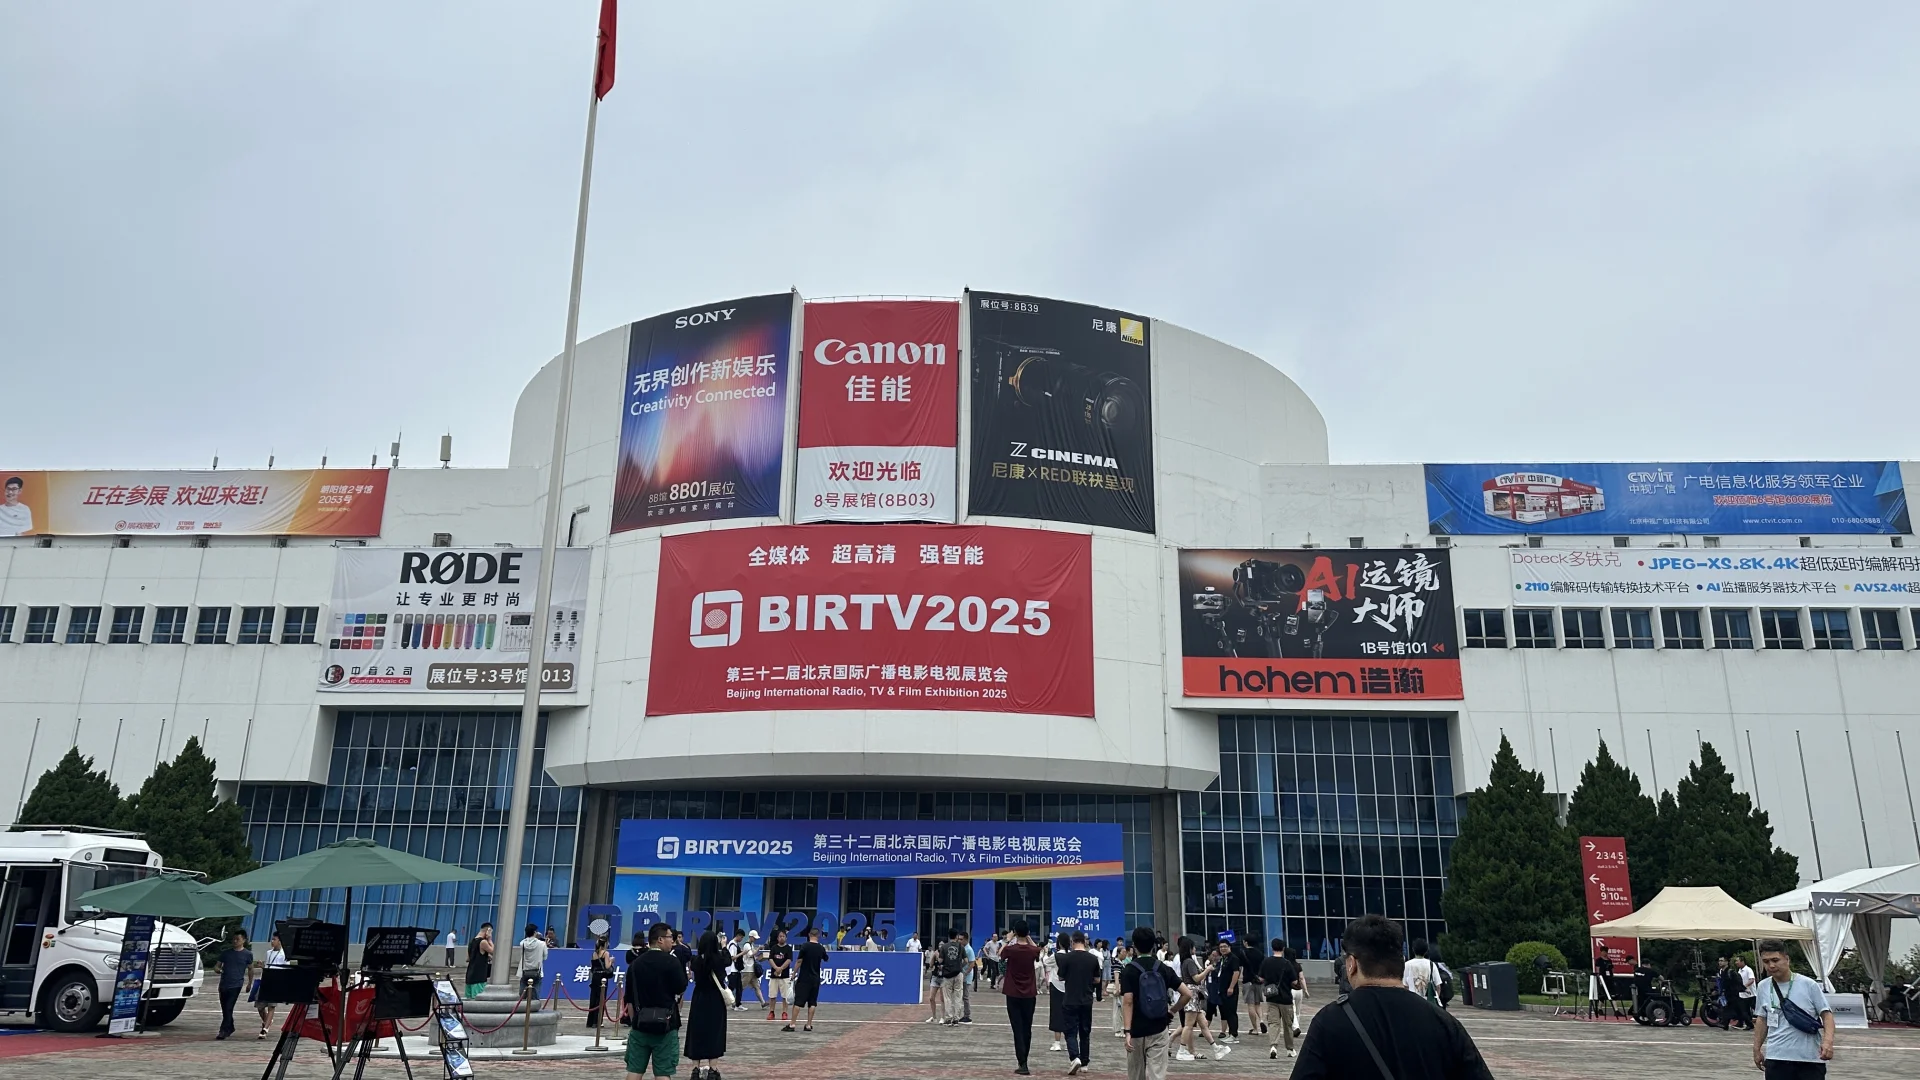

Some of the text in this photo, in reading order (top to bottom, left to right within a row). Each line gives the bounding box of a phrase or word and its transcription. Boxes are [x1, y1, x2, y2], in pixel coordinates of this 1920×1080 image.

[980, 299, 1039, 313] 展位号:8B39
[675, 308, 736, 329] SONY
[1092, 319, 1117, 333] 尼康
[1121, 335, 1143, 344] Nikon
[814, 339, 946, 365] Canon
[633, 354, 776, 396] 无界创作新娱乐
[845, 375, 912, 402] 佳能
[630, 382, 776, 416] Creativity Connected
[1031, 448, 1119, 469] CINEMA
[828, 461, 922, 481] 欢迎光临
[1629, 484, 1676, 494] 中视广信
[1684, 474, 1865, 489] 广电信息化服务领军企业
[83, 485, 269, 506] 正在参展 欢迎来逛!
[318, 495, 352, 504] 2053号
[649, 481, 735, 503] 8B馆 8B01展位
[814, 492, 935, 509] 8号展馆(8B03)
[748, 544, 984, 566] 全媒体 超高清 强智能
[1512, 551, 1622, 567] Doteck多铁克
[1296, 553, 1443, 612] AI 运镜
[1525, 581, 1690, 594] 2110编解码传输转换技术平台
[1706, 581, 1837, 594] AI监播服务器技术平台
[396, 592, 520, 607] 让专业更时尚
[758, 593, 1051, 636] BIRTV2025
[1352, 593, 1426, 641] 大师
[1360, 641, 1428, 655] 1B号馆101
[351, 666, 412, 676] 中音公司
[726, 664, 1008, 683] 第三十二届北京国际广播电影电视展览会
[1219, 665, 1425, 694] hohem 浩瀚
[726, 686, 1007, 700] Beijing International Radio, TV & Film Exhibition 2025
[684, 839, 793, 855] BIRTV2025
[813, 834, 1082, 852] 第三十二届北京国际广播电影电视展览会
[813, 851, 1082, 865] Beijing International Radio, TV & Film Exhibition 2025
[637, 891, 660, 902] 2A馆
[1076, 896, 1099, 907] 2B馆
[1819, 898, 1860, 907] NSH
[637, 903, 659, 913] 1A馆
[1077, 909, 1099, 920] 1B馆
[631, 911, 897, 946] BIRTV2025
